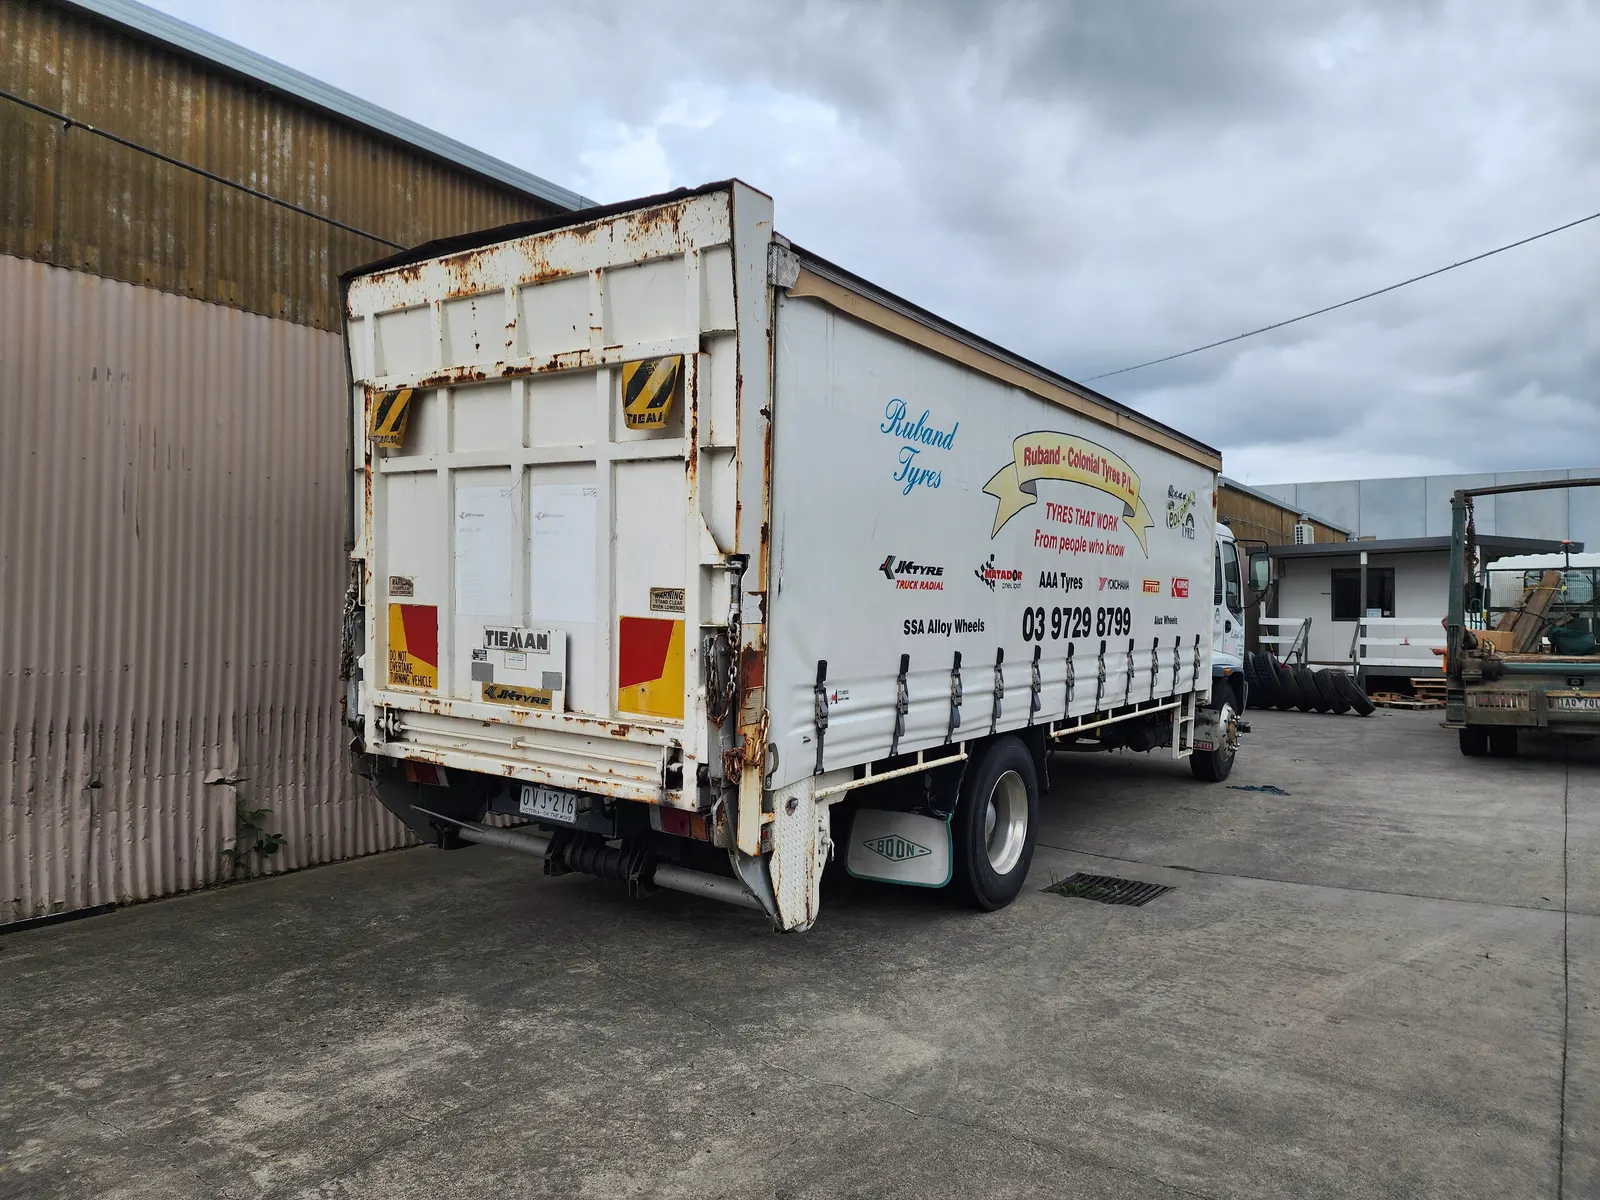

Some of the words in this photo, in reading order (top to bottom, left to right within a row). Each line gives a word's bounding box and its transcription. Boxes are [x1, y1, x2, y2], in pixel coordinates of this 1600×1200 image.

[880, 398, 959, 451] Ruband
[893, 446, 942, 495] Tyres
[1023, 445, 1061, 467] Ruband
[1067, 446, 1100, 475] Colonial
[1101, 458, 1120, 483] Tyres
[1046, 502, 1074, 525] TYRES
[1075, 508, 1096, 528] THAT
[1096, 512, 1119, 532] WORK
[1034, 528, 1058, 549] From
[1058, 535, 1087, 556] people
[1088, 538, 1105, 555] who
[1105, 539, 1126, 557] know
[895, 580, 919, 590] TRUCK
[919, 580, 944, 591] RADIAL
[985, 569, 1023, 582] MATADOR
[1039, 571, 1058, 589] AAA
[1060, 572, 1083, 593] Tyres
[903, 618, 925, 636] SSA
[927, 618, 953, 638] Alloy
[954, 618, 985, 634] Wheels
[1022, 606, 1045, 642] 03
[1050, 606, 1092, 640] 9729
[1096, 606, 1131, 638] 8799
[485, 629, 548, 650] TIEMAN
[389, 649, 396, 661] DO
[397, 650, 407, 662] NOT
[389, 660, 413, 675] OVERTAKE
[389, 671, 410, 685] TURNING
[411, 674, 432, 688] VEHICLE
[877, 838, 915, 858] BOON
